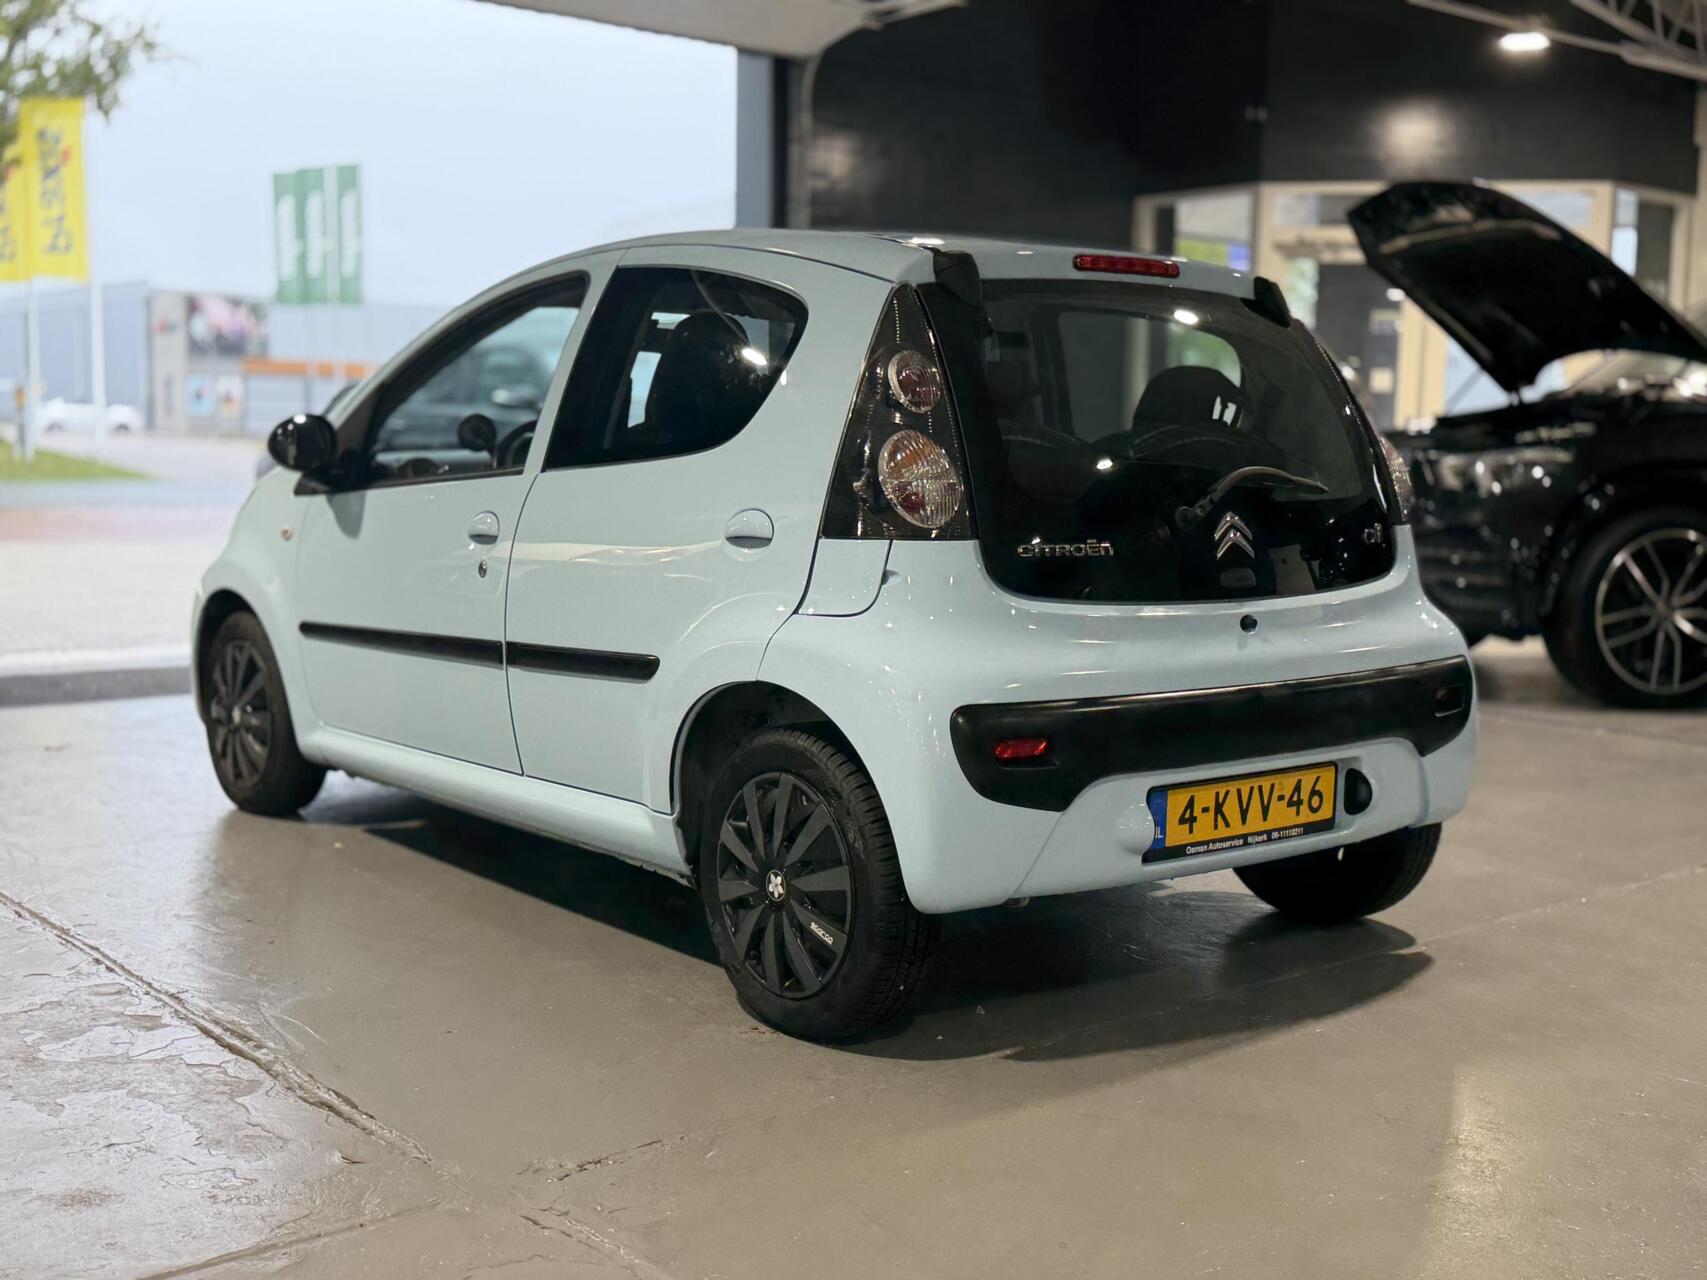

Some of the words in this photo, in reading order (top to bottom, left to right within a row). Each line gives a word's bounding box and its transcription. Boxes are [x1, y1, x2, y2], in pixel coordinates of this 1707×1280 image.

[1178, 775, 1324, 835] 4-KVV-46
[1185, 844, 1208, 855] Osman
[1208, 838, 1244, 850] Autoservice
